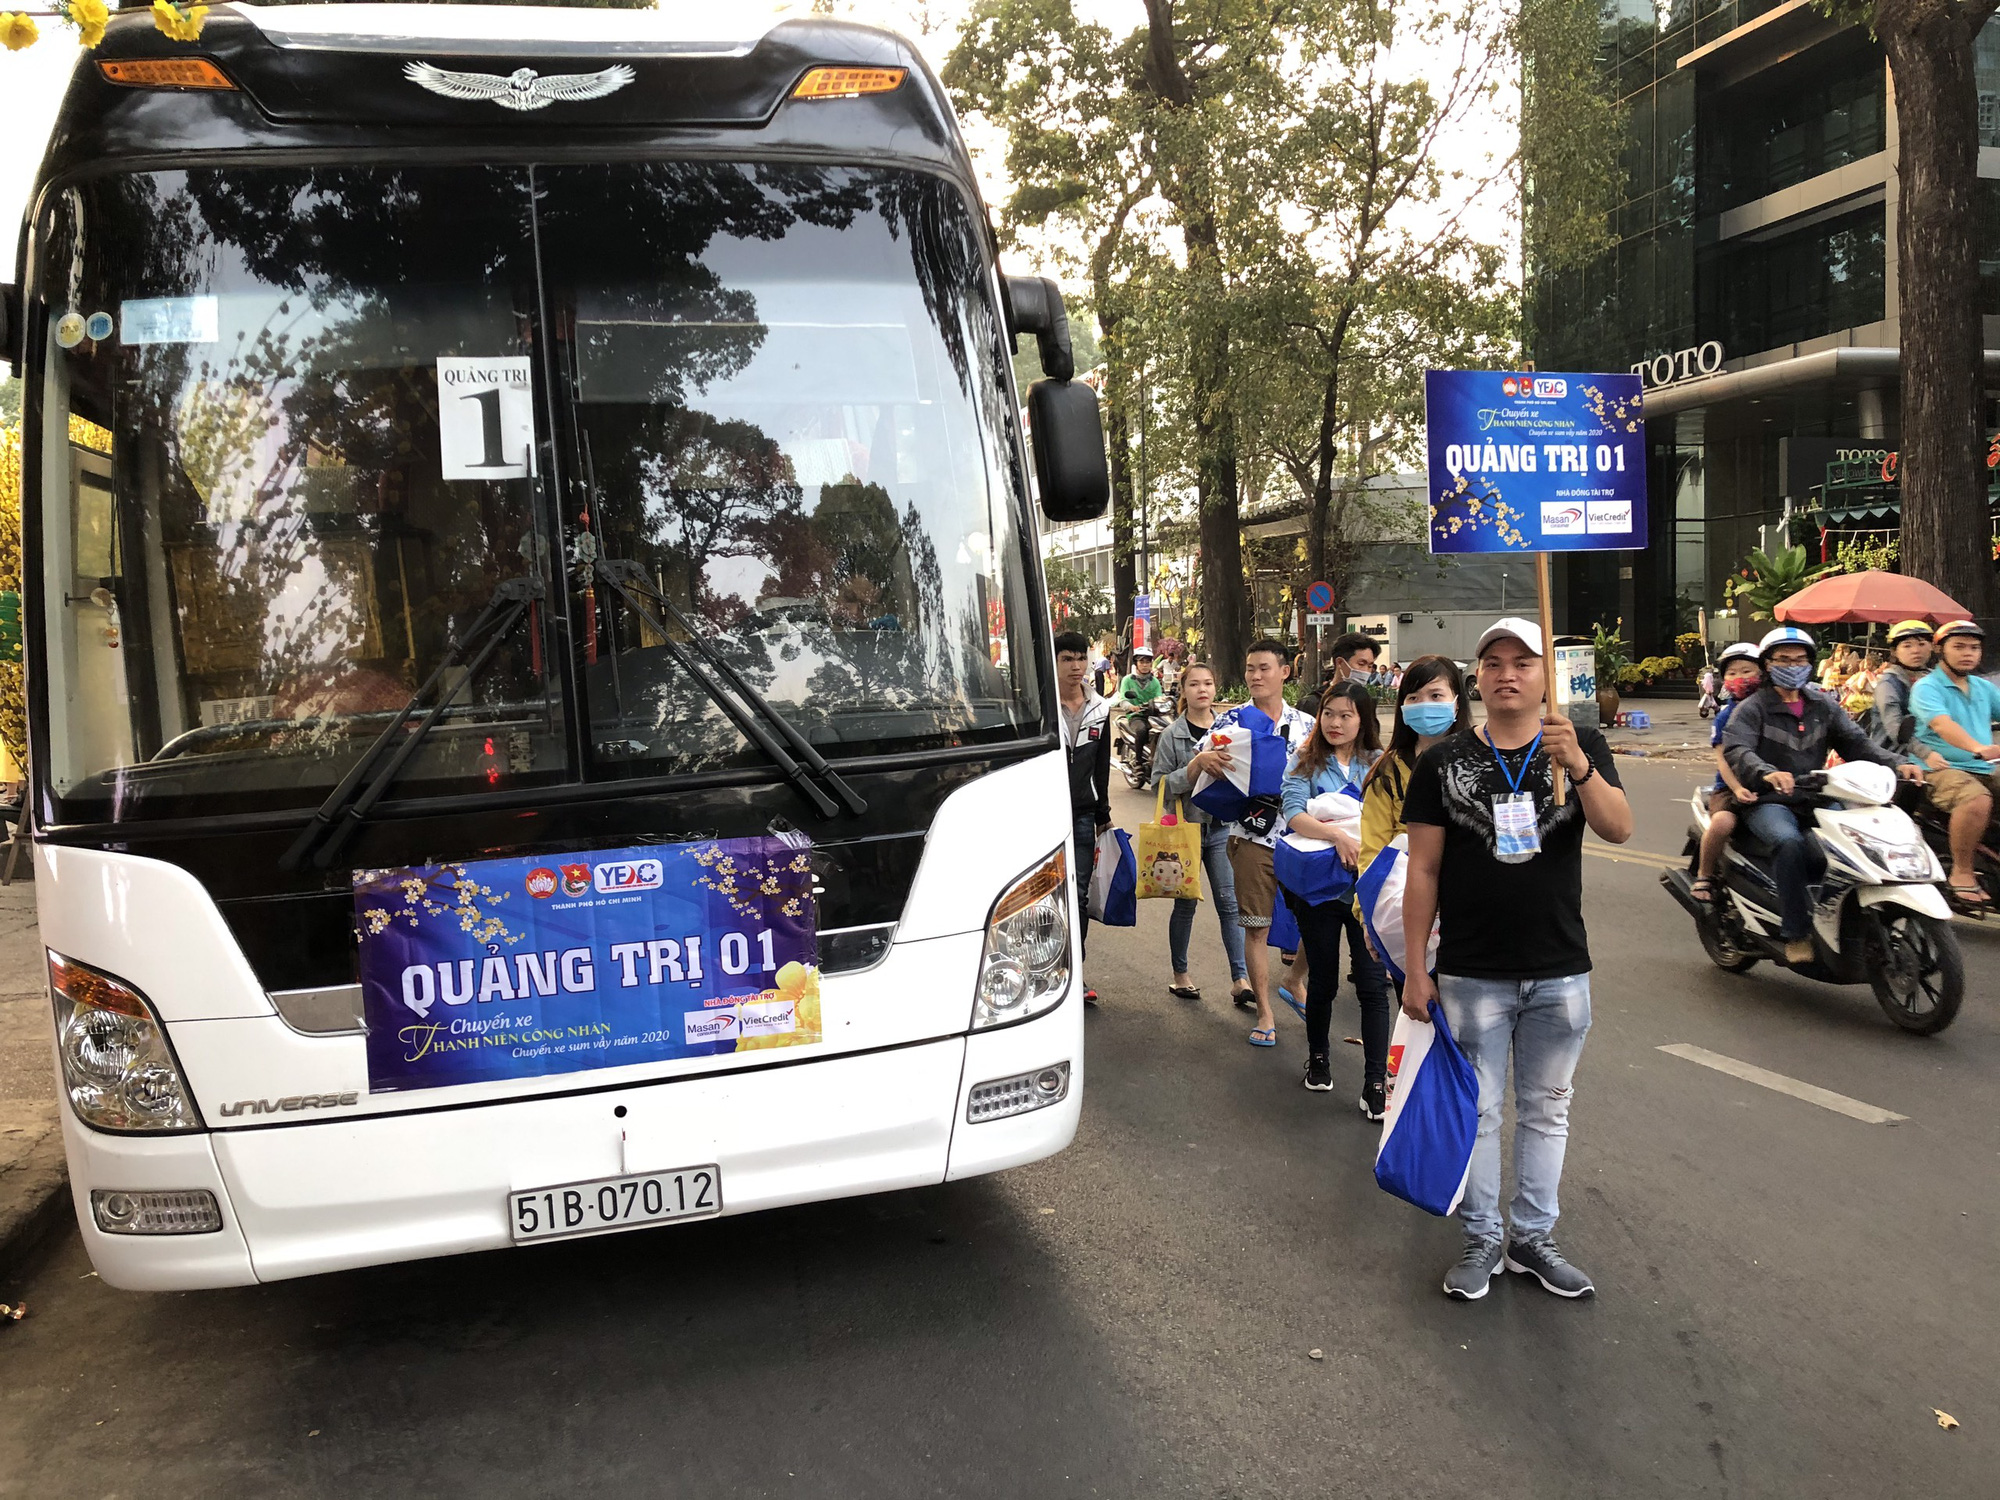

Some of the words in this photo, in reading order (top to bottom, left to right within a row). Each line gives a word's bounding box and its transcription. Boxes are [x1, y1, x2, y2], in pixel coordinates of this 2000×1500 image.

[445, 366, 498, 386] QUẢNG
[502, 369, 527, 387] TRỊ
[1631, 341, 1723, 388] TOTO
[1530, 410, 1539, 418] xe
[459, 388, 523, 467] 1
[1446, 437, 1537, 478] QUẢNG
[1544, 444, 1588, 477] TRỊ
[1595, 444, 1625, 472] 01
[1543, 514, 1569, 524] Masan
[1588, 513, 1627, 521] VietCredit
[401, 944, 595, 1018] QUẢNG
[611, 936, 703, 988] TRỊ
[719, 928, 777, 975] 01
[450, 1012, 511, 1036] Chuyến
[514, 1013, 533, 1027] xe
[687, 1022, 721, 1034] Masan
[743, 1013, 789, 1026] VietCredit
[483, 1031, 518, 1048] NIÊN
[522, 1026, 564, 1044] CÔNG
[512, 1041, 551, 1059] Chuyến
[553, 1043, 566, 1053] xe
[568, 1040, 590, 1052] sum
[614, 1035, 638, 1046] năm
[641, 1030, 670, 1044] 2020
[220, 1091, 358, 1117] UNIVERSE
[518, 1172, 713, 1233] 51B-070.12
